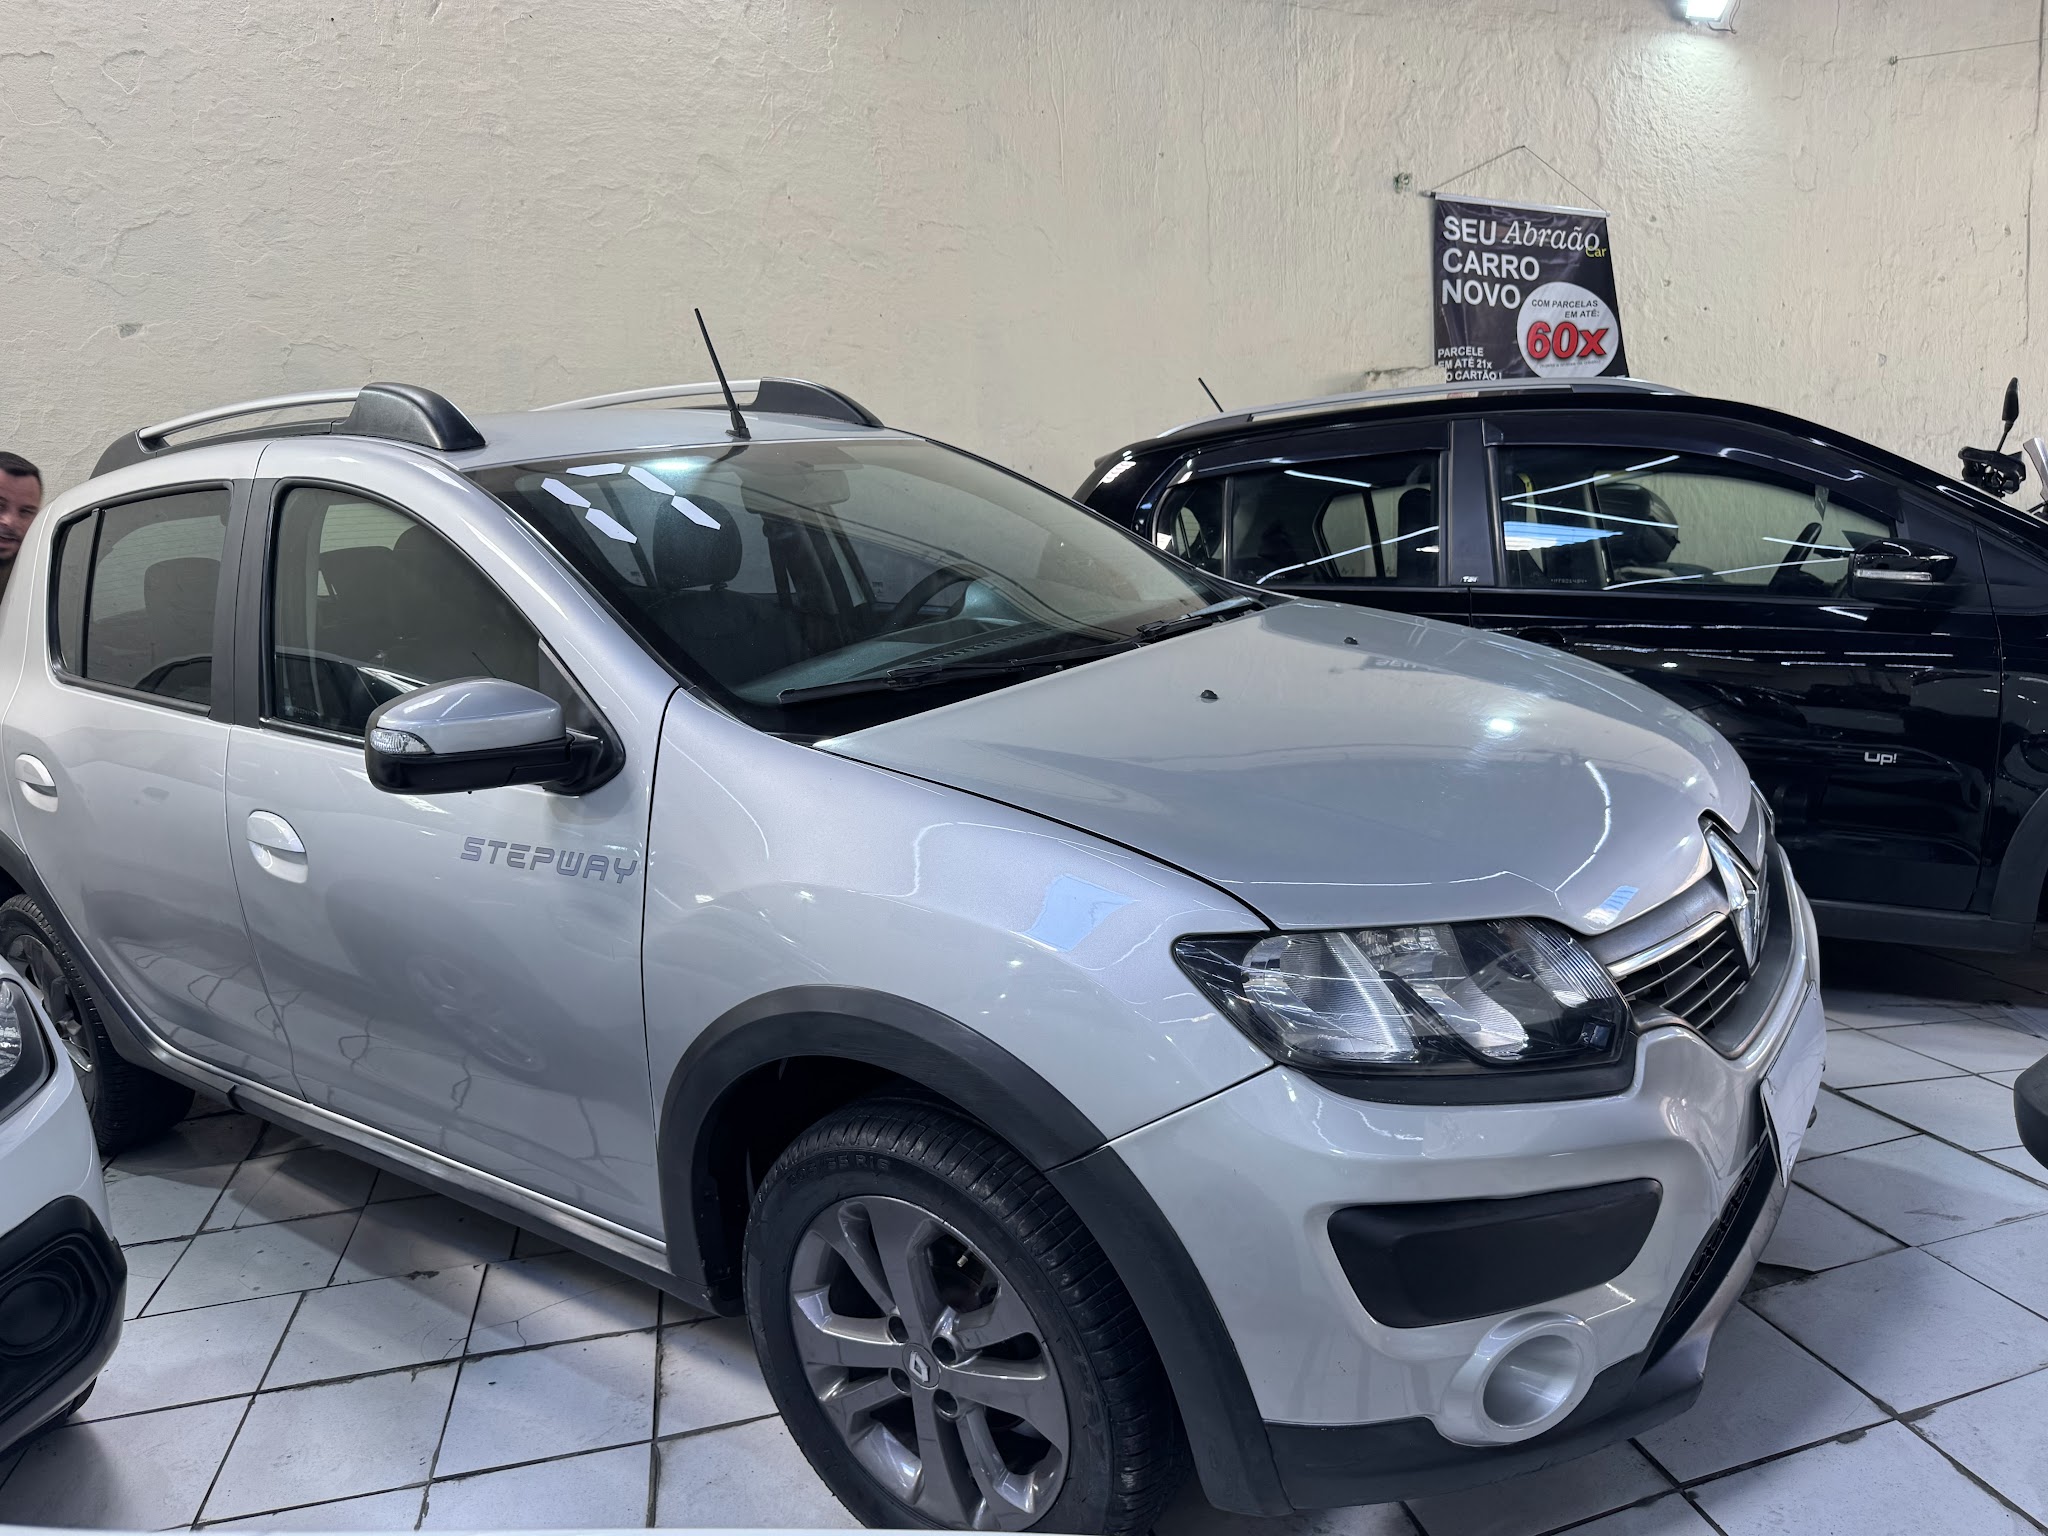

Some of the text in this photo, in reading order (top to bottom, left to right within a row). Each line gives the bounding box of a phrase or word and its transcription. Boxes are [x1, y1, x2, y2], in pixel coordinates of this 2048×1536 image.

[1443, 215, 1600, 252] SEU Abraão
[1585, 246, 1607, 258] Car
[1442, 247, 1540, 282] CARRO
[1441, 279, 1521, 310] NOVO
[1531, 299, 1599, 309] COM PARCELAS
[1564, 310, 1578, 319] EM
[1526, 320, 1609, 361] 60x
[1438, 346, 1484, 358] PARCELE
[1454, 356, 1475, 368] ATÉ
[1476, 358, 1492, 369] 21x
[1454, 369, 1497, 381] CARTÃO
[460, 836, 638, 884] STEPWAY
